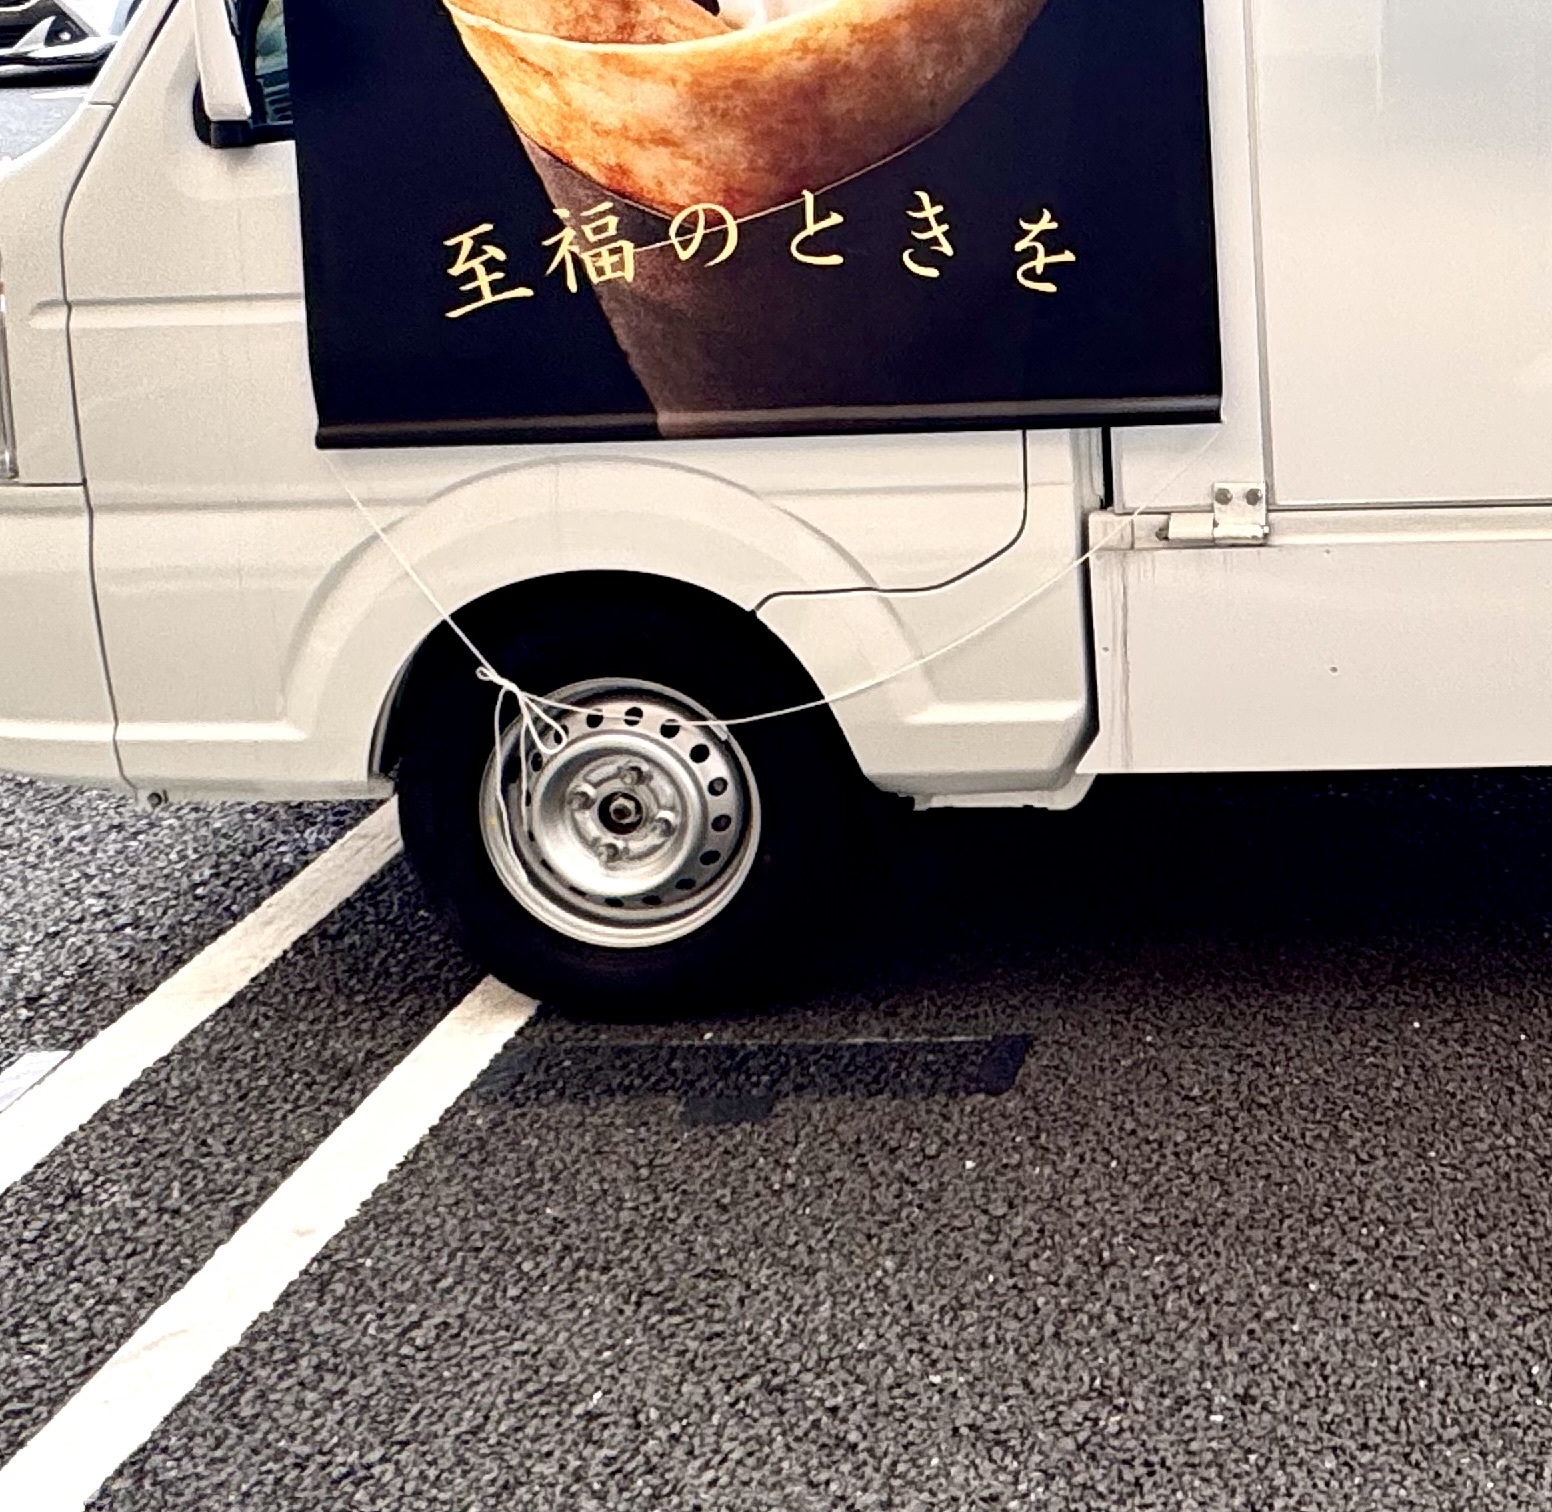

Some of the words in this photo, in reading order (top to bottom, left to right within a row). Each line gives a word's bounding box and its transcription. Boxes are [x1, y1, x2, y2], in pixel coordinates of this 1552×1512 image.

[443, 188, 1077, 318] 至福のときを
